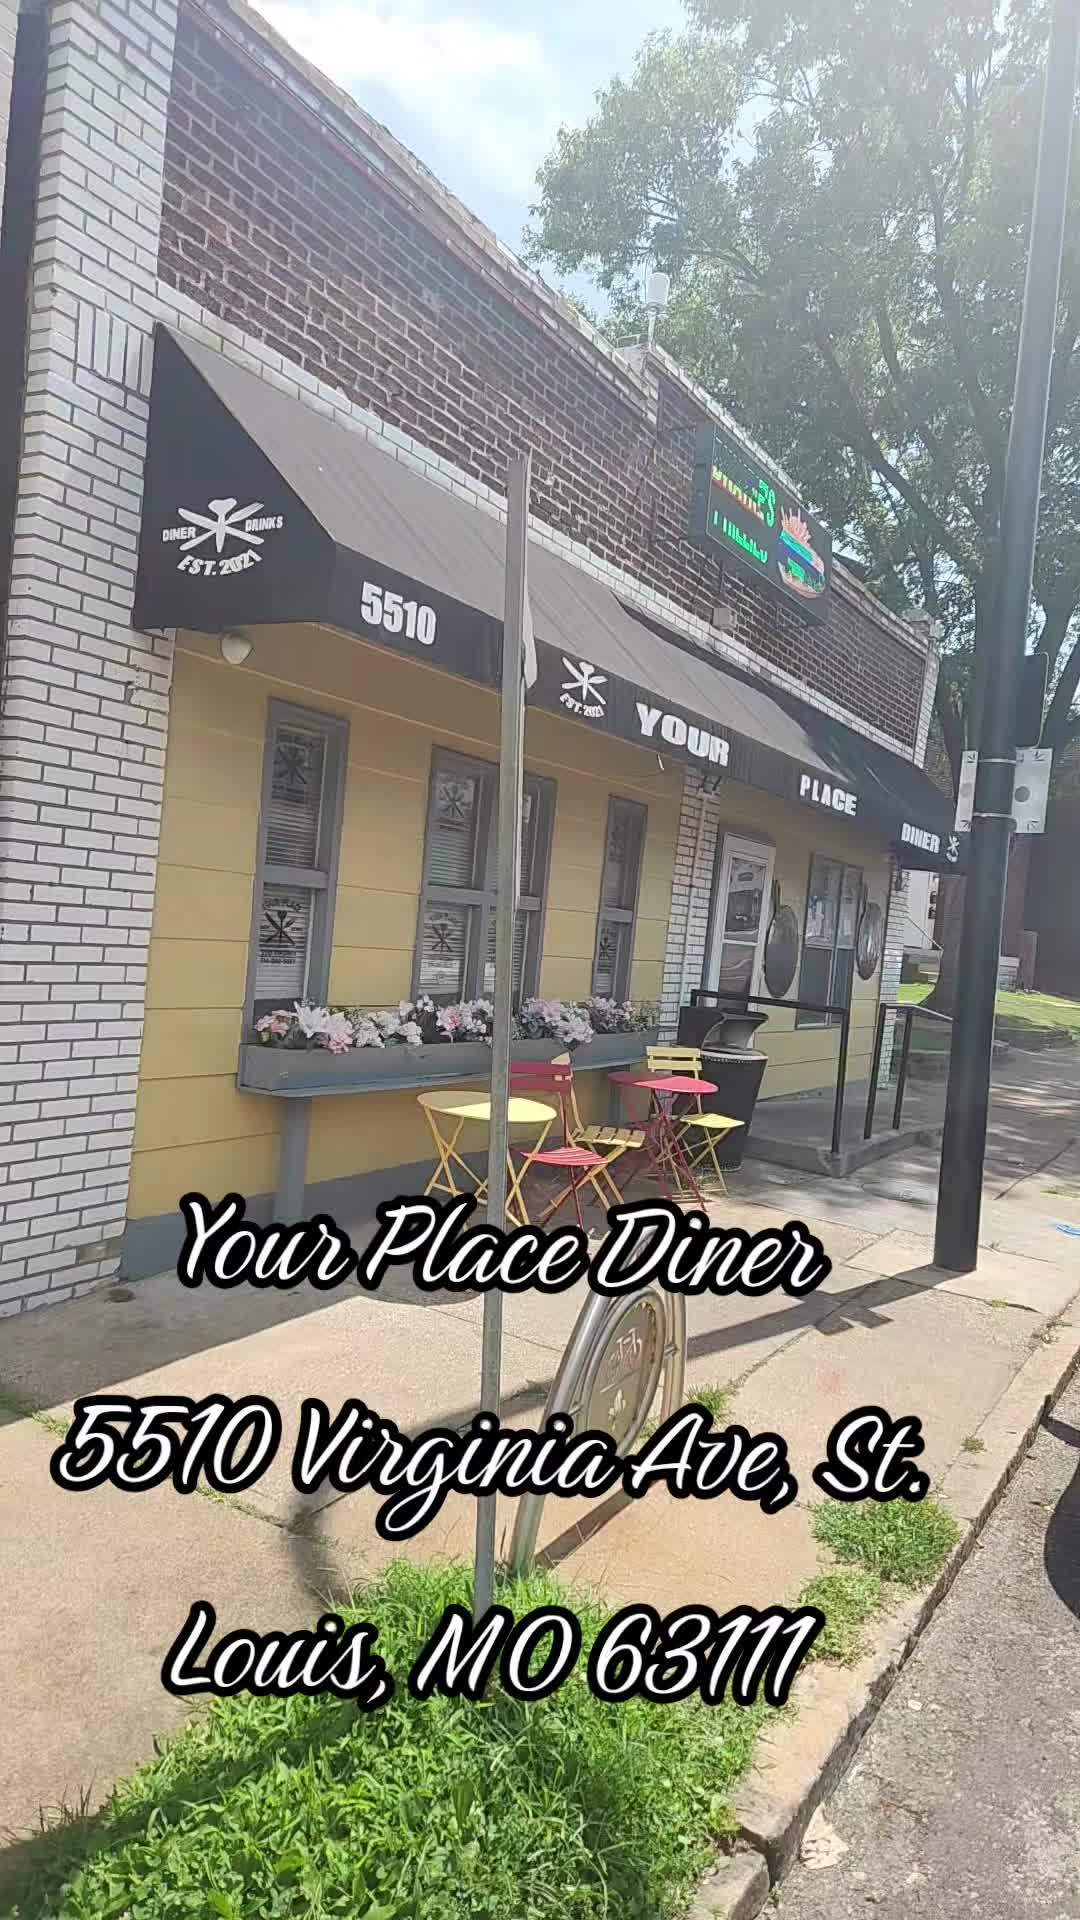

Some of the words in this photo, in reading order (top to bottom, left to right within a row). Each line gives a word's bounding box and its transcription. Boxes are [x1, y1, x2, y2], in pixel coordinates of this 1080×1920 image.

[162, 526, 197, 542] DINER
[245, 515, 284, 532] DRINKS
[177, 554, 216, 576] EST.
[218, 548, 263, 575] 2021
[360, 580, 437, 646] 5510
[635, 702, 731, 768] YOUR
[799, 774, 857, 816] PLACE
[900, 822, 941, 854] DINER
